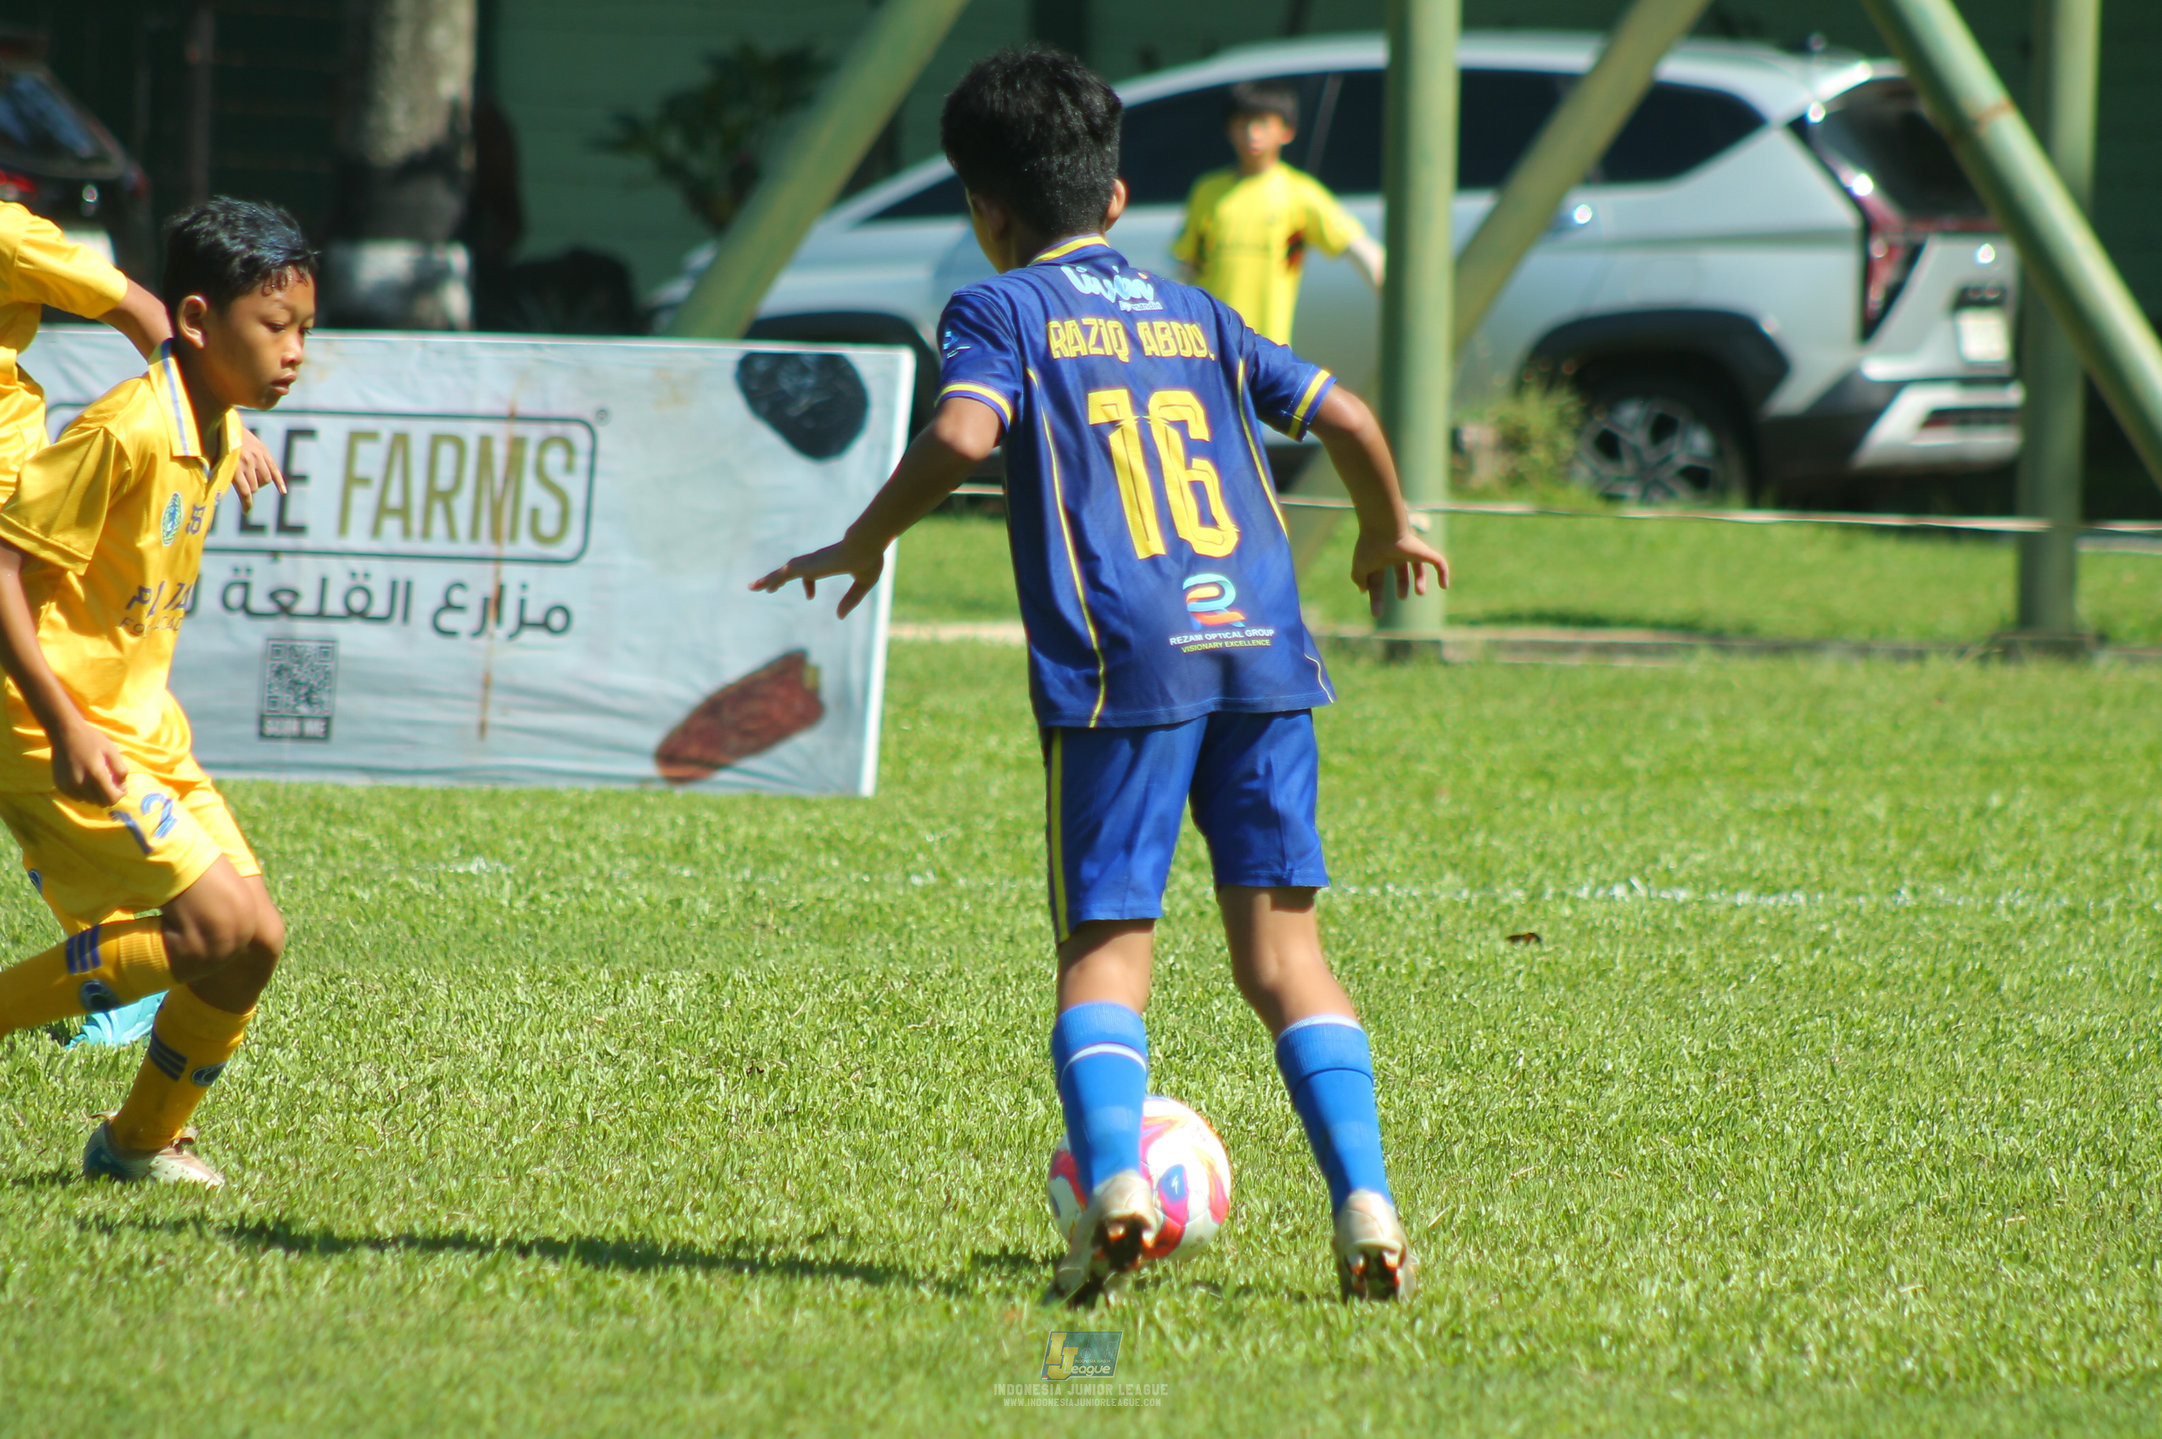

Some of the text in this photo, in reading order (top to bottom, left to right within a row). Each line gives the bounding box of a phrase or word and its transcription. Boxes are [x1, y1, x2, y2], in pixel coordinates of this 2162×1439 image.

[1047, 317, 1216, 363] RAZIQ ABDU
[337, 430, 577, 546] FARMS
[1087, 388, 1241, 560] 16
[220, 566, 414, 625] القلعة
[432, 582, 573, 639] مزارع
[1169, 628, 1275, 646] REZAM OPTICAL GROUP
[1181, 639, 1271, 653] VISIONARY EXCELLENCE
[109, 793, 177, 855] 12
